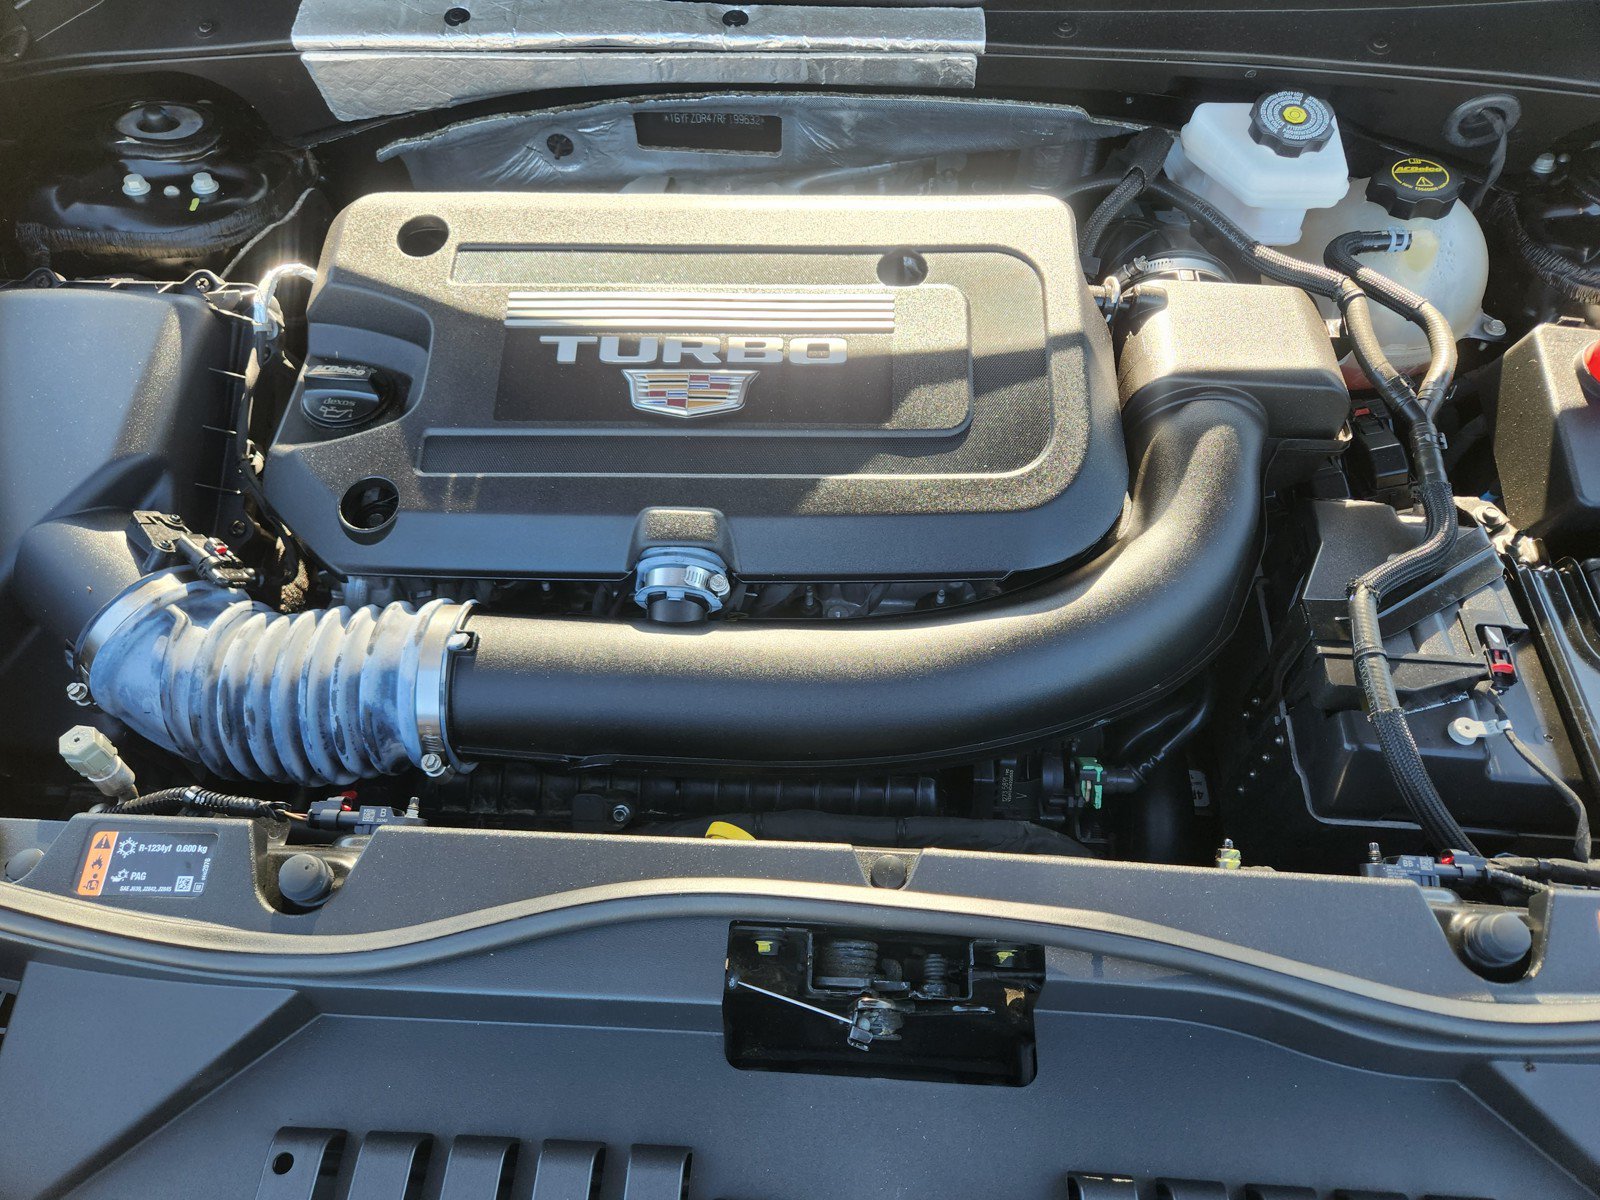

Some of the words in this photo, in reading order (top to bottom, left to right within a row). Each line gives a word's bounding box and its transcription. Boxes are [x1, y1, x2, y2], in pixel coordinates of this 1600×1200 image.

[539, 335, 848, 364] TURBO
[311, 364, 366, 376] ACDelco
[323, 397, 356, 407] dexos
[138, 844, 172, 854] R-1234yf
[176, 844, 197, 853] 0.600
[197, 844, 208, 855] kg
[130, 871, 147, 882] PAG
[119, 885, 130, 893] SAE
